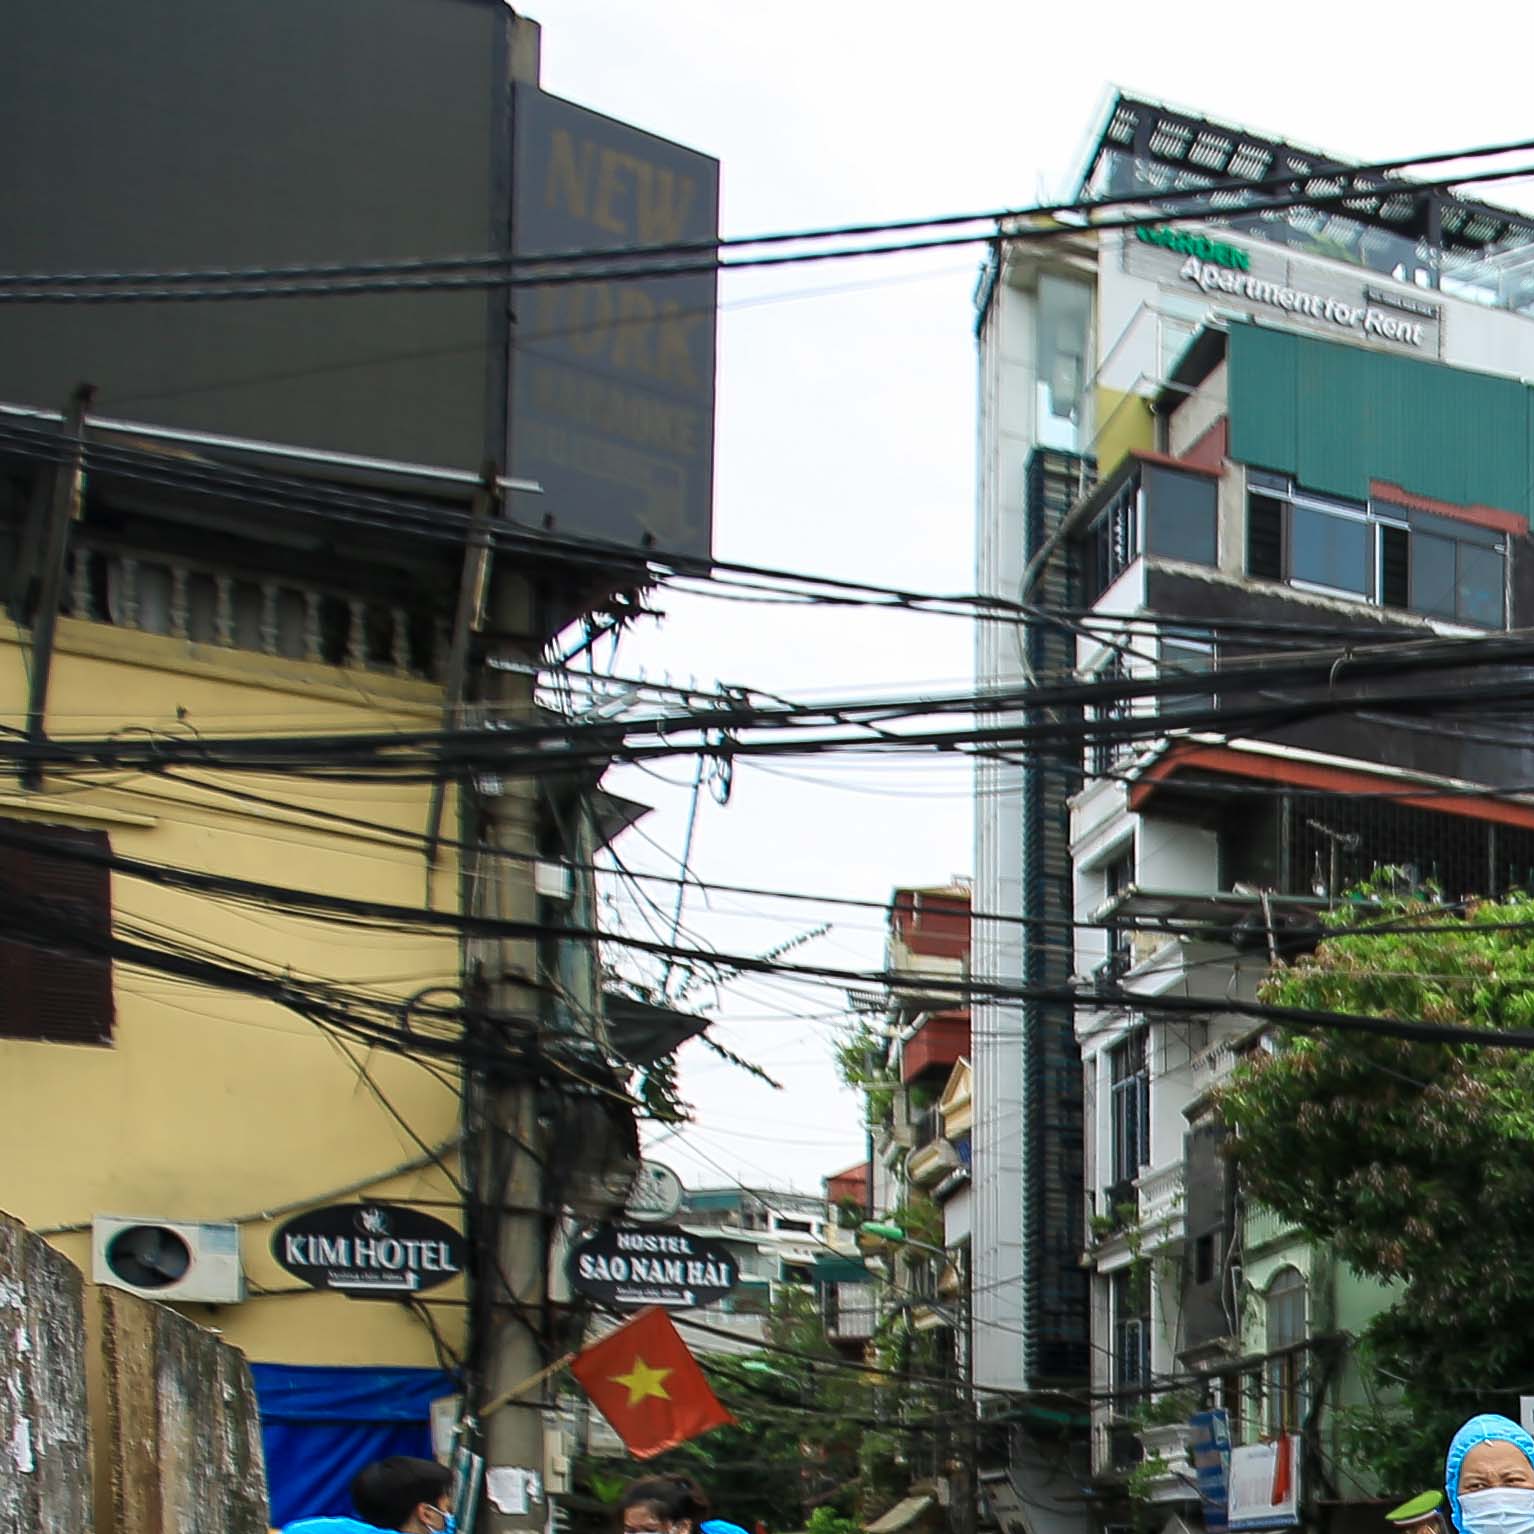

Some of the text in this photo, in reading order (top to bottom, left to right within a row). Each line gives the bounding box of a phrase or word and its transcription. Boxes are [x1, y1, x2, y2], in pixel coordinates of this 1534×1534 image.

[1180, 255, 1322, 317] Apartment
[1326, 296, 1364, 326] for
[1366, 309, 1424, 346] Rent
[284, 1233, 460, 1272] KIM HOTEL
[617, 1232, 693, 1255] HOSTEL
[578, 1254, 625, 1281] SAO
[630, 1258, 684, 1286] NAM
